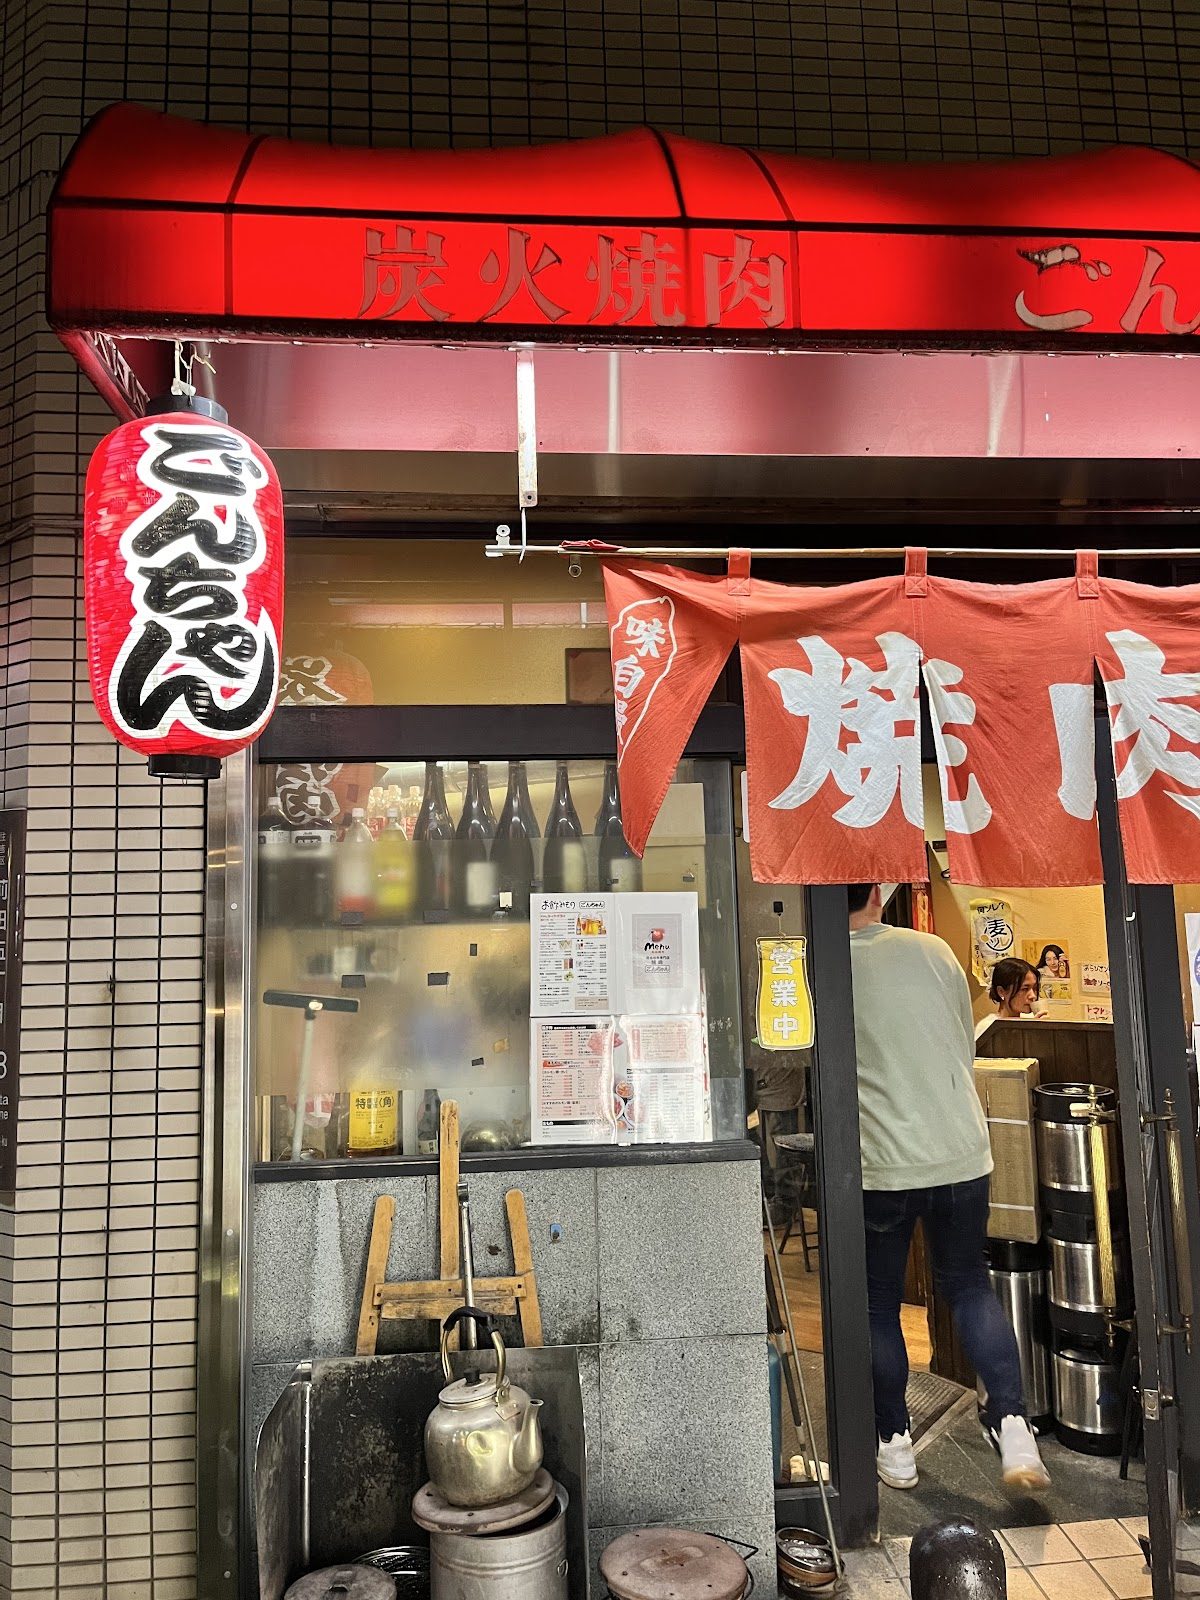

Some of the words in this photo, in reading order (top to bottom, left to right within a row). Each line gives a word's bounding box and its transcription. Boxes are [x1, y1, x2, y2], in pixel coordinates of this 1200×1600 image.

[358, 224, 787, 329] 炭火焼肉
[1015, 243, 1200, 334] ごん
[112, 425, 276, 736] ごんちゃん
[768, 629, 1200, 835] 焼肉
[644, 942, 670, 951] Menu
[769, 946, 799, 1041] 営業中
